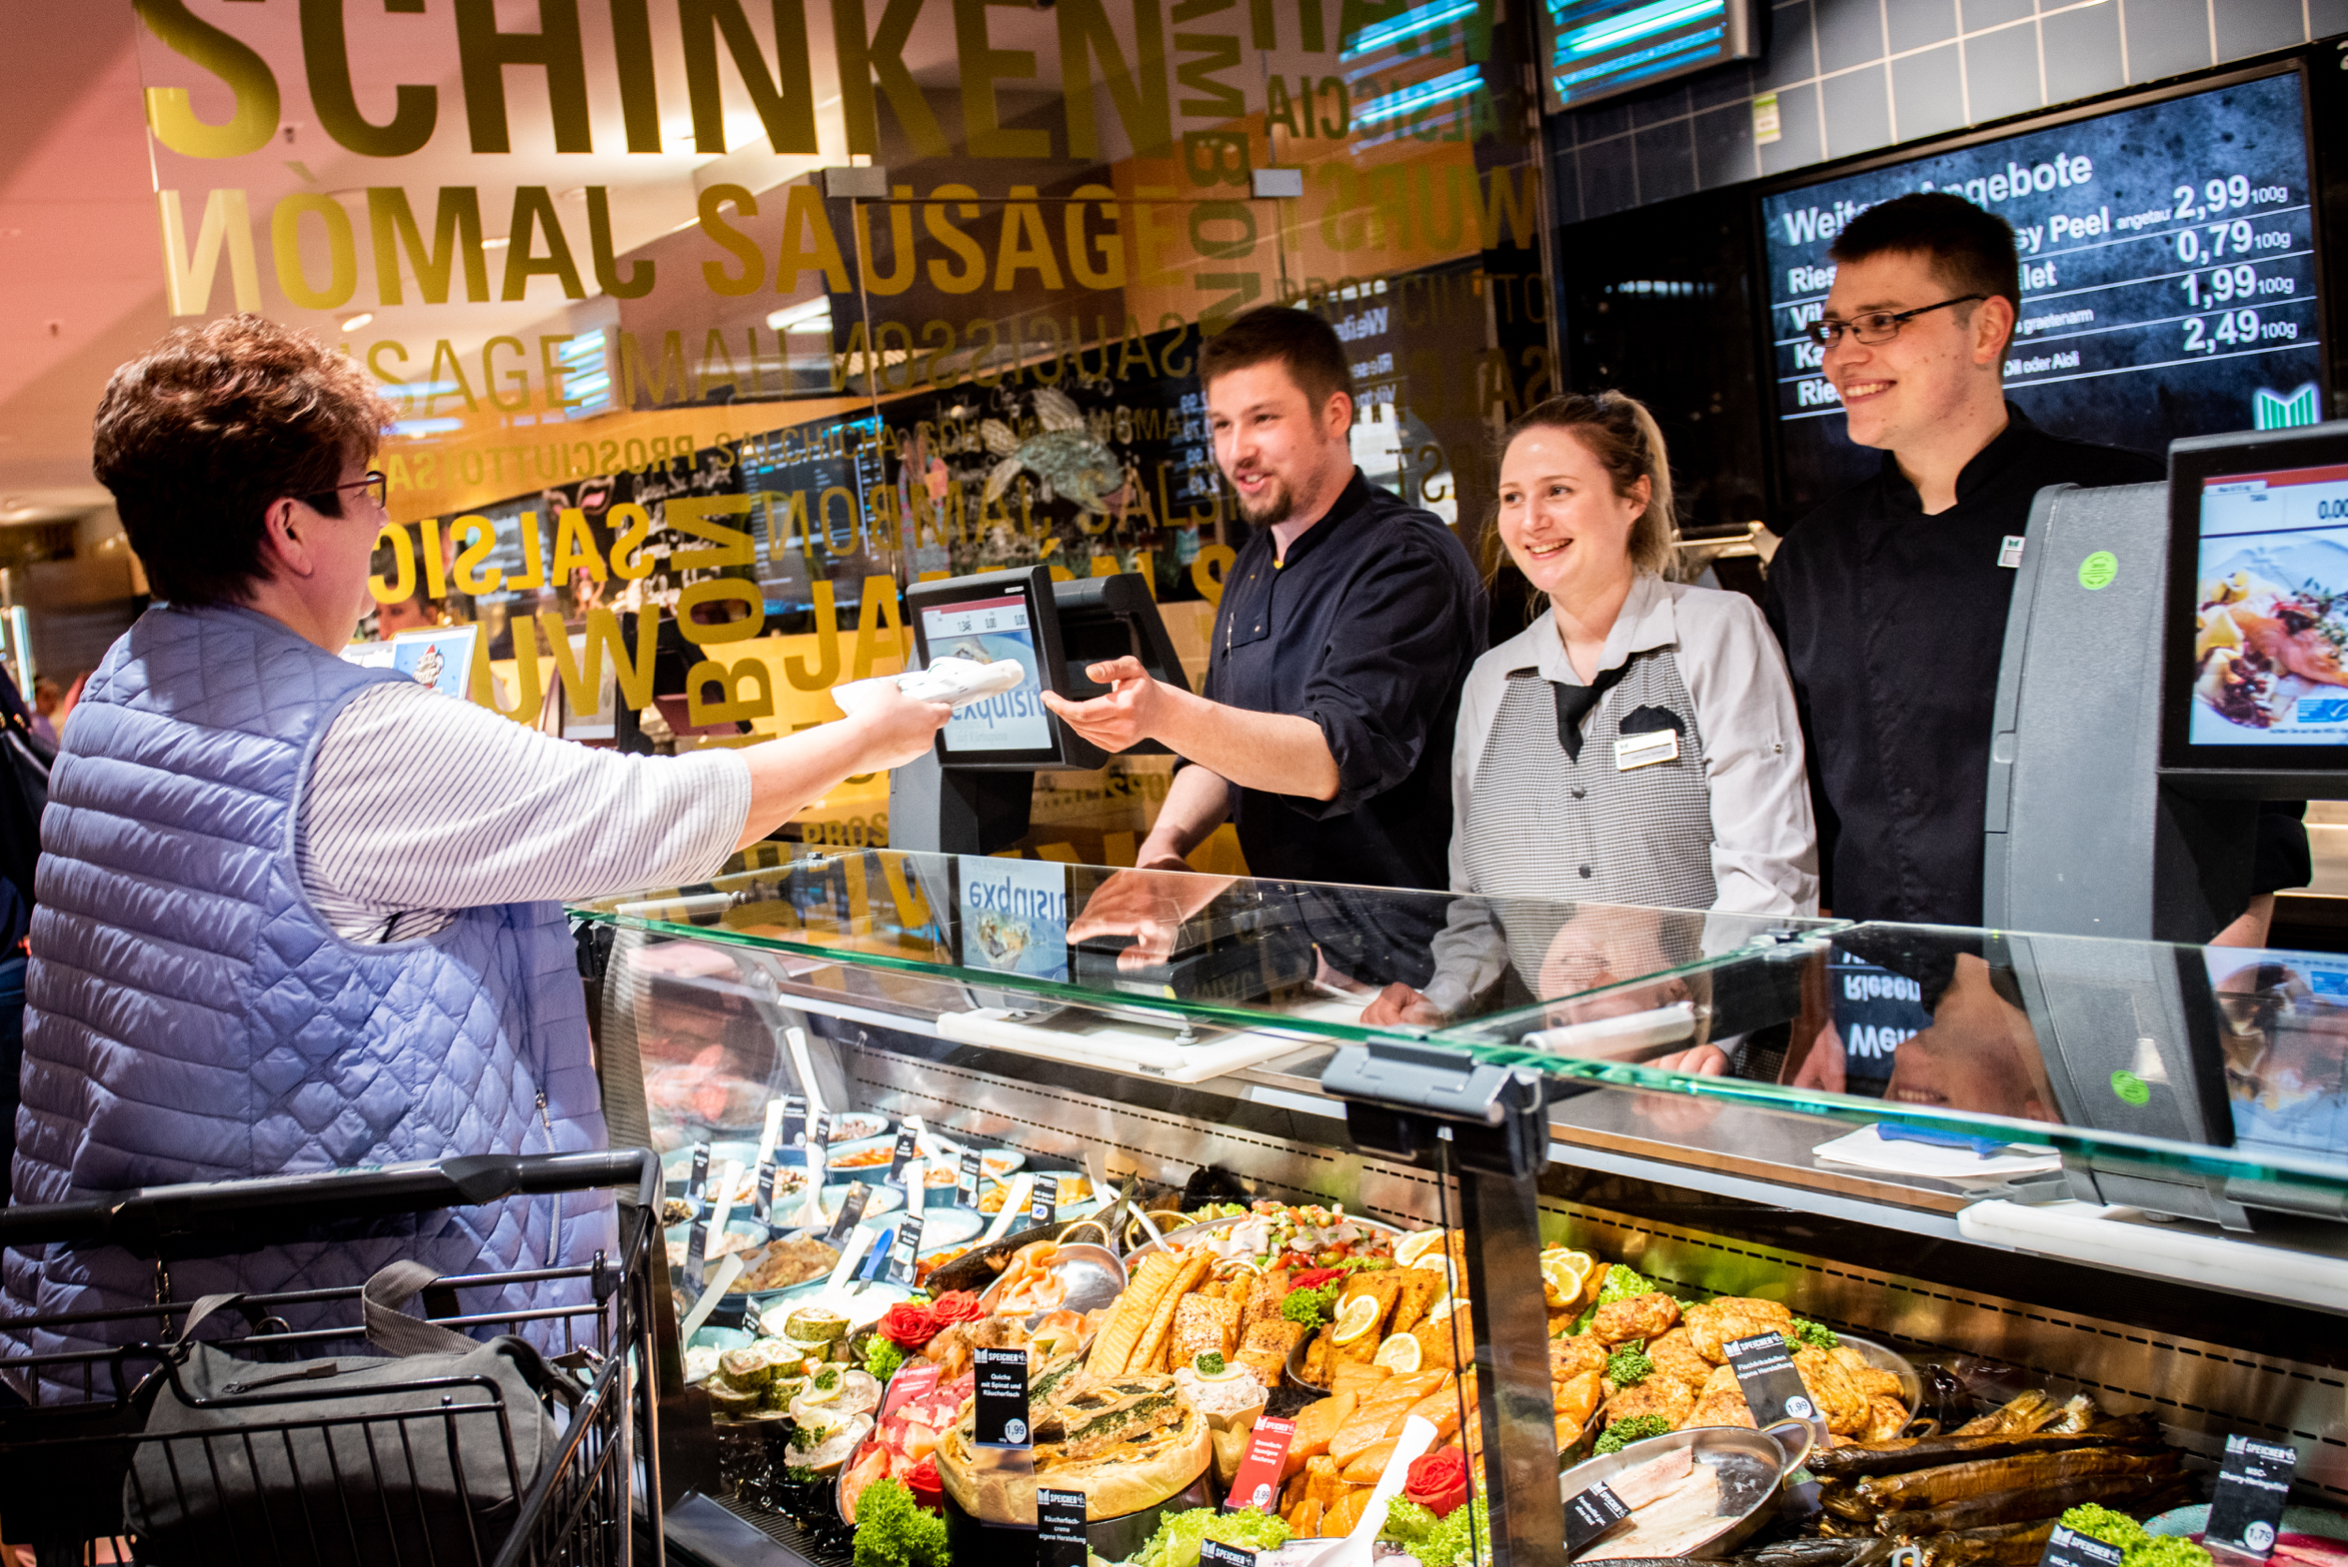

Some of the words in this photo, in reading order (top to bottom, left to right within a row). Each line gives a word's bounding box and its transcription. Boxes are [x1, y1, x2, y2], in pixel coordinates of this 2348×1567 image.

[134, 0, 1172, 160] SCHINKEN
[2049, 206, 2110, 241] Peel
[2173, 174, 2250, 221] 2,99
[2250, 186, 2288, 204] 100g
[698, 182, 1186, 296] SAUSAGE
[2176, 219, 2253, 265] 0,79
[2254, 231, 2291, 250] 100g
[2180, 264, 2257, 310] 1,99
[2257, 276, 2295, 295] 100g
[2182, 309, 2260, 355] 2,49
[2260, 321, 2298, 340] 100g
[1006, 1424, 1025, 1436] 1,99
[2249, 1528, 2273, 1542] 1,79
